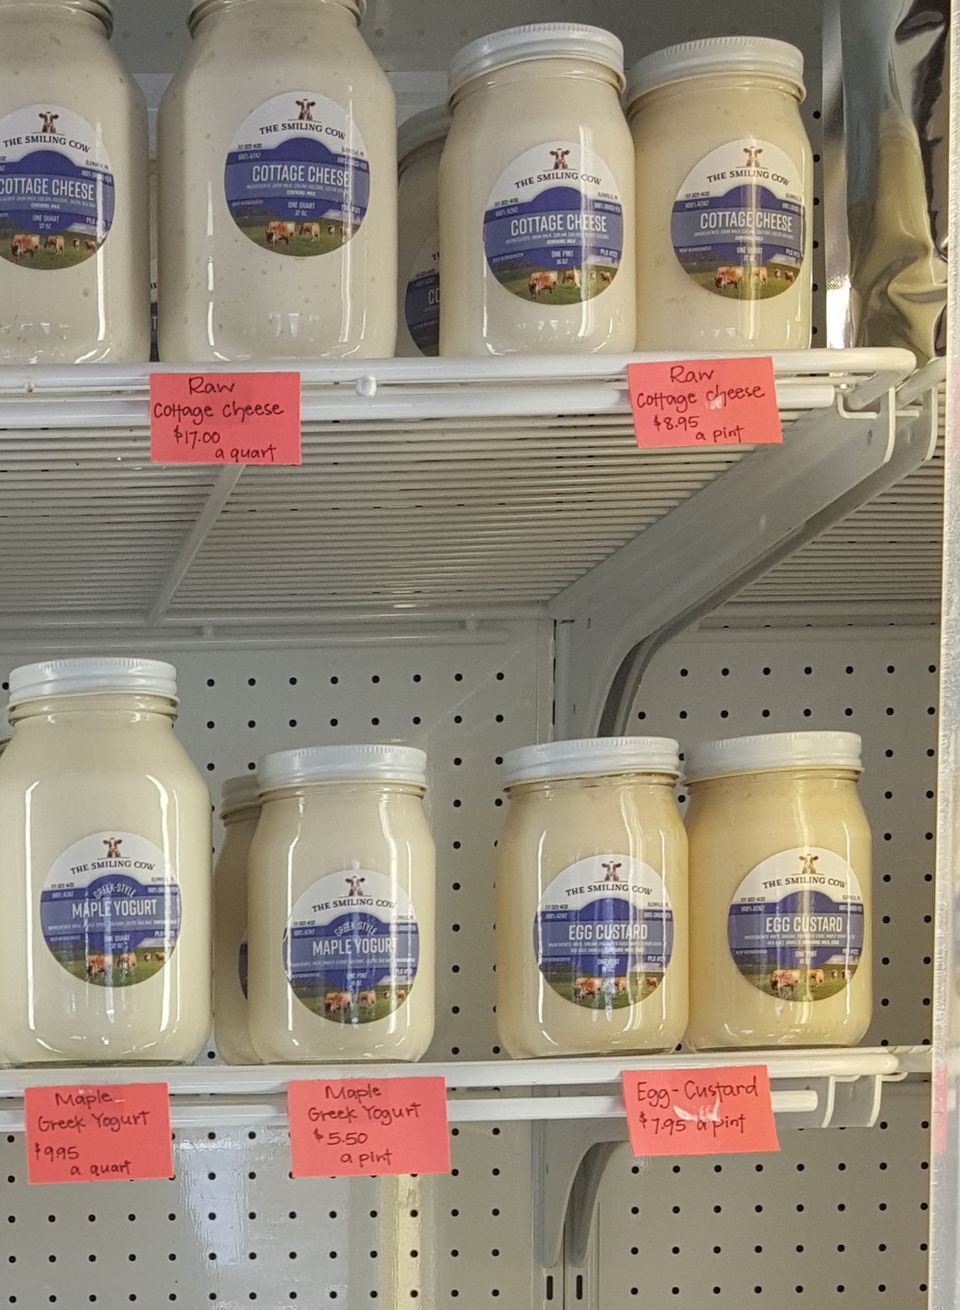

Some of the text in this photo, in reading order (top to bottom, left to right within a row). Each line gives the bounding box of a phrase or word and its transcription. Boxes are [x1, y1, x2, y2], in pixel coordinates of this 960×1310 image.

[253, 166, 304, 182] COTTAGE
[308, 166, 351, 188] CHEESE
[52, 179, 94, 200] CHEESE
[511, 214, 607, 236] COTTAGE CHEESE
[700, 211, 793, 232] COTTAGE CHEESE
[670, 366, 714, 383] Raw
[189, 377, 235, 394] Raw
[154, 403, 213, 425] Cottage
[654, 415, 700, 431] $8.95
[174, 425, 220, 449] $17.00
[696, 425, 743, 443] a pint
[215, 445, 276, 462] a quart
[72, 900, 157, 919] MAPLE YOGURT
[569, 924, 648, 940] EGG CUSTARD
[766, 916, 842, 932] EGG CUSTARD
[313, 938, 397, 955] MAPLE YOGURT
[55, 1090, 112, 1109] Maple
[326, 1084, 381, 1103] Maple
[38, 1111, 149, 1132] Greek Yogurt
[308, 1102, 420, 1125] Greek Yogurt
[639, 1112, 746, 1137] $7.95 a pint
[313, 1129, 367, 1145] $5.50
[341, 1149, 392, 1167] a pint
[70, 1160, 131, 1176] a quart
